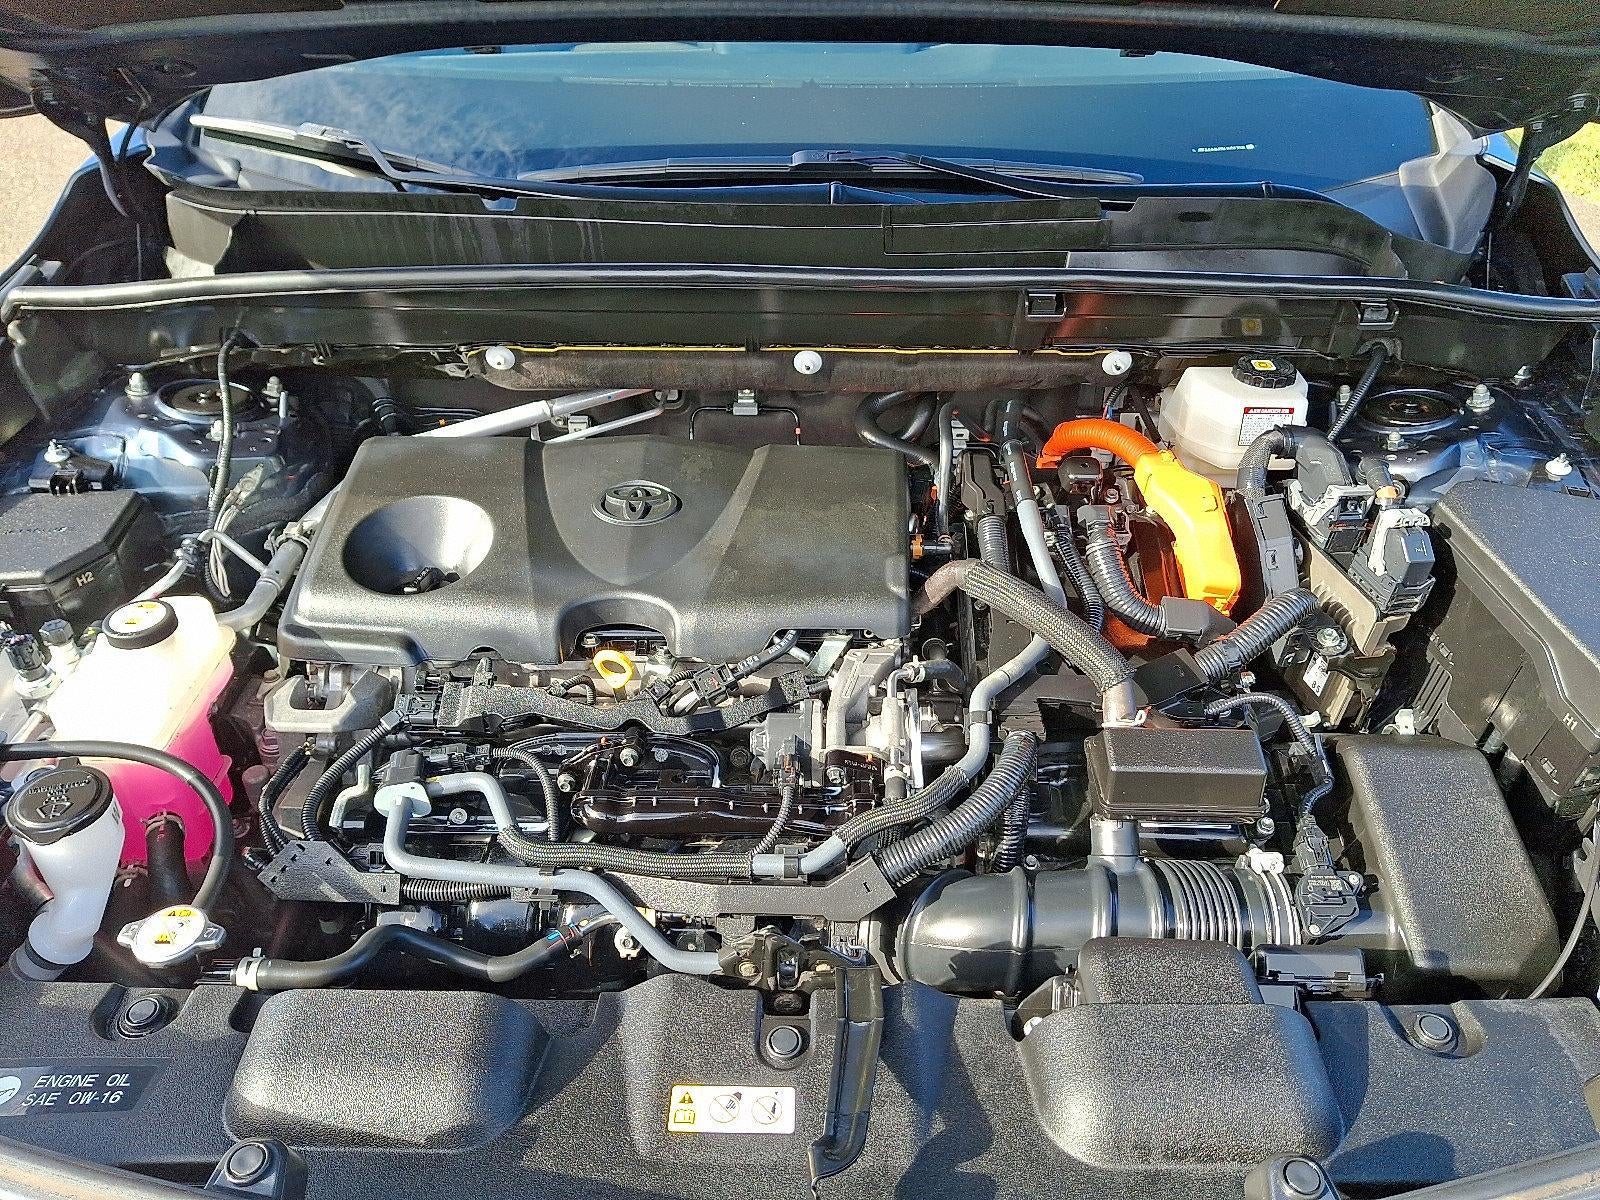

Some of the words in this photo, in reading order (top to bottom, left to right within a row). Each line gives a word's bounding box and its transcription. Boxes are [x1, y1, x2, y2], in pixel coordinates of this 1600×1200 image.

[76, 571, 94, 587] H2
[1562, 712, 1578, 730] H1
[33, 1074, 99, 1089] ENGINE
[105, 1073, 131, 1087] OIL
[22, 1092, 61, 1107] SAE
[68, 1091, 123, 1105] 0W-16
